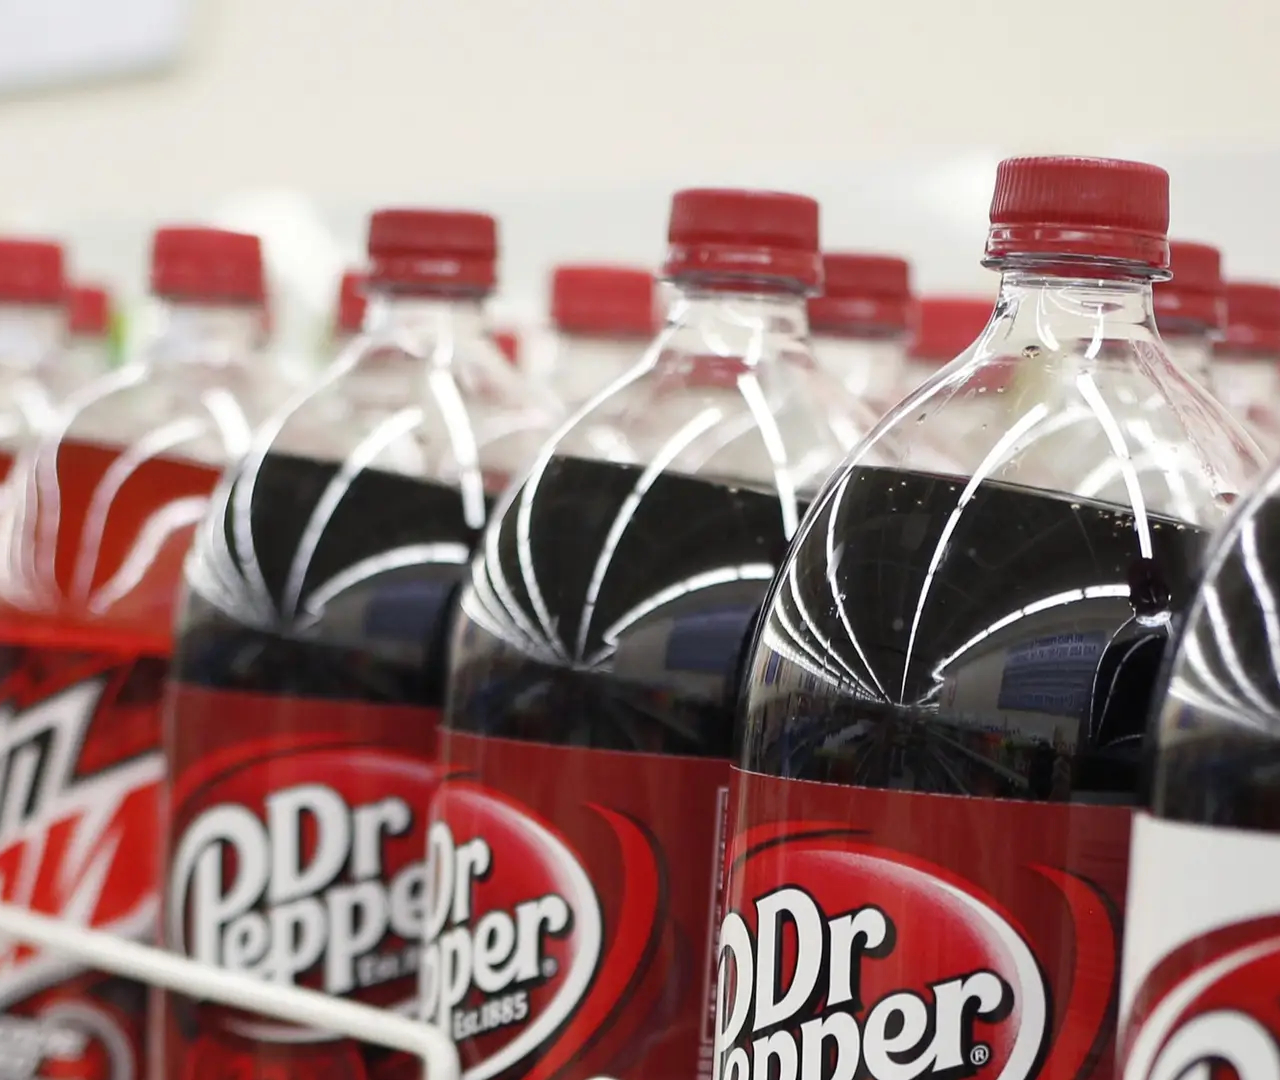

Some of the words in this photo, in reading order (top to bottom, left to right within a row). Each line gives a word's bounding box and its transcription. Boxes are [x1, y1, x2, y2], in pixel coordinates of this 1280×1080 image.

[171, 803, 429, 995] Peppe
[264, 783, 412, 905] Dr
[753, 888, 887, 1032] Dr
